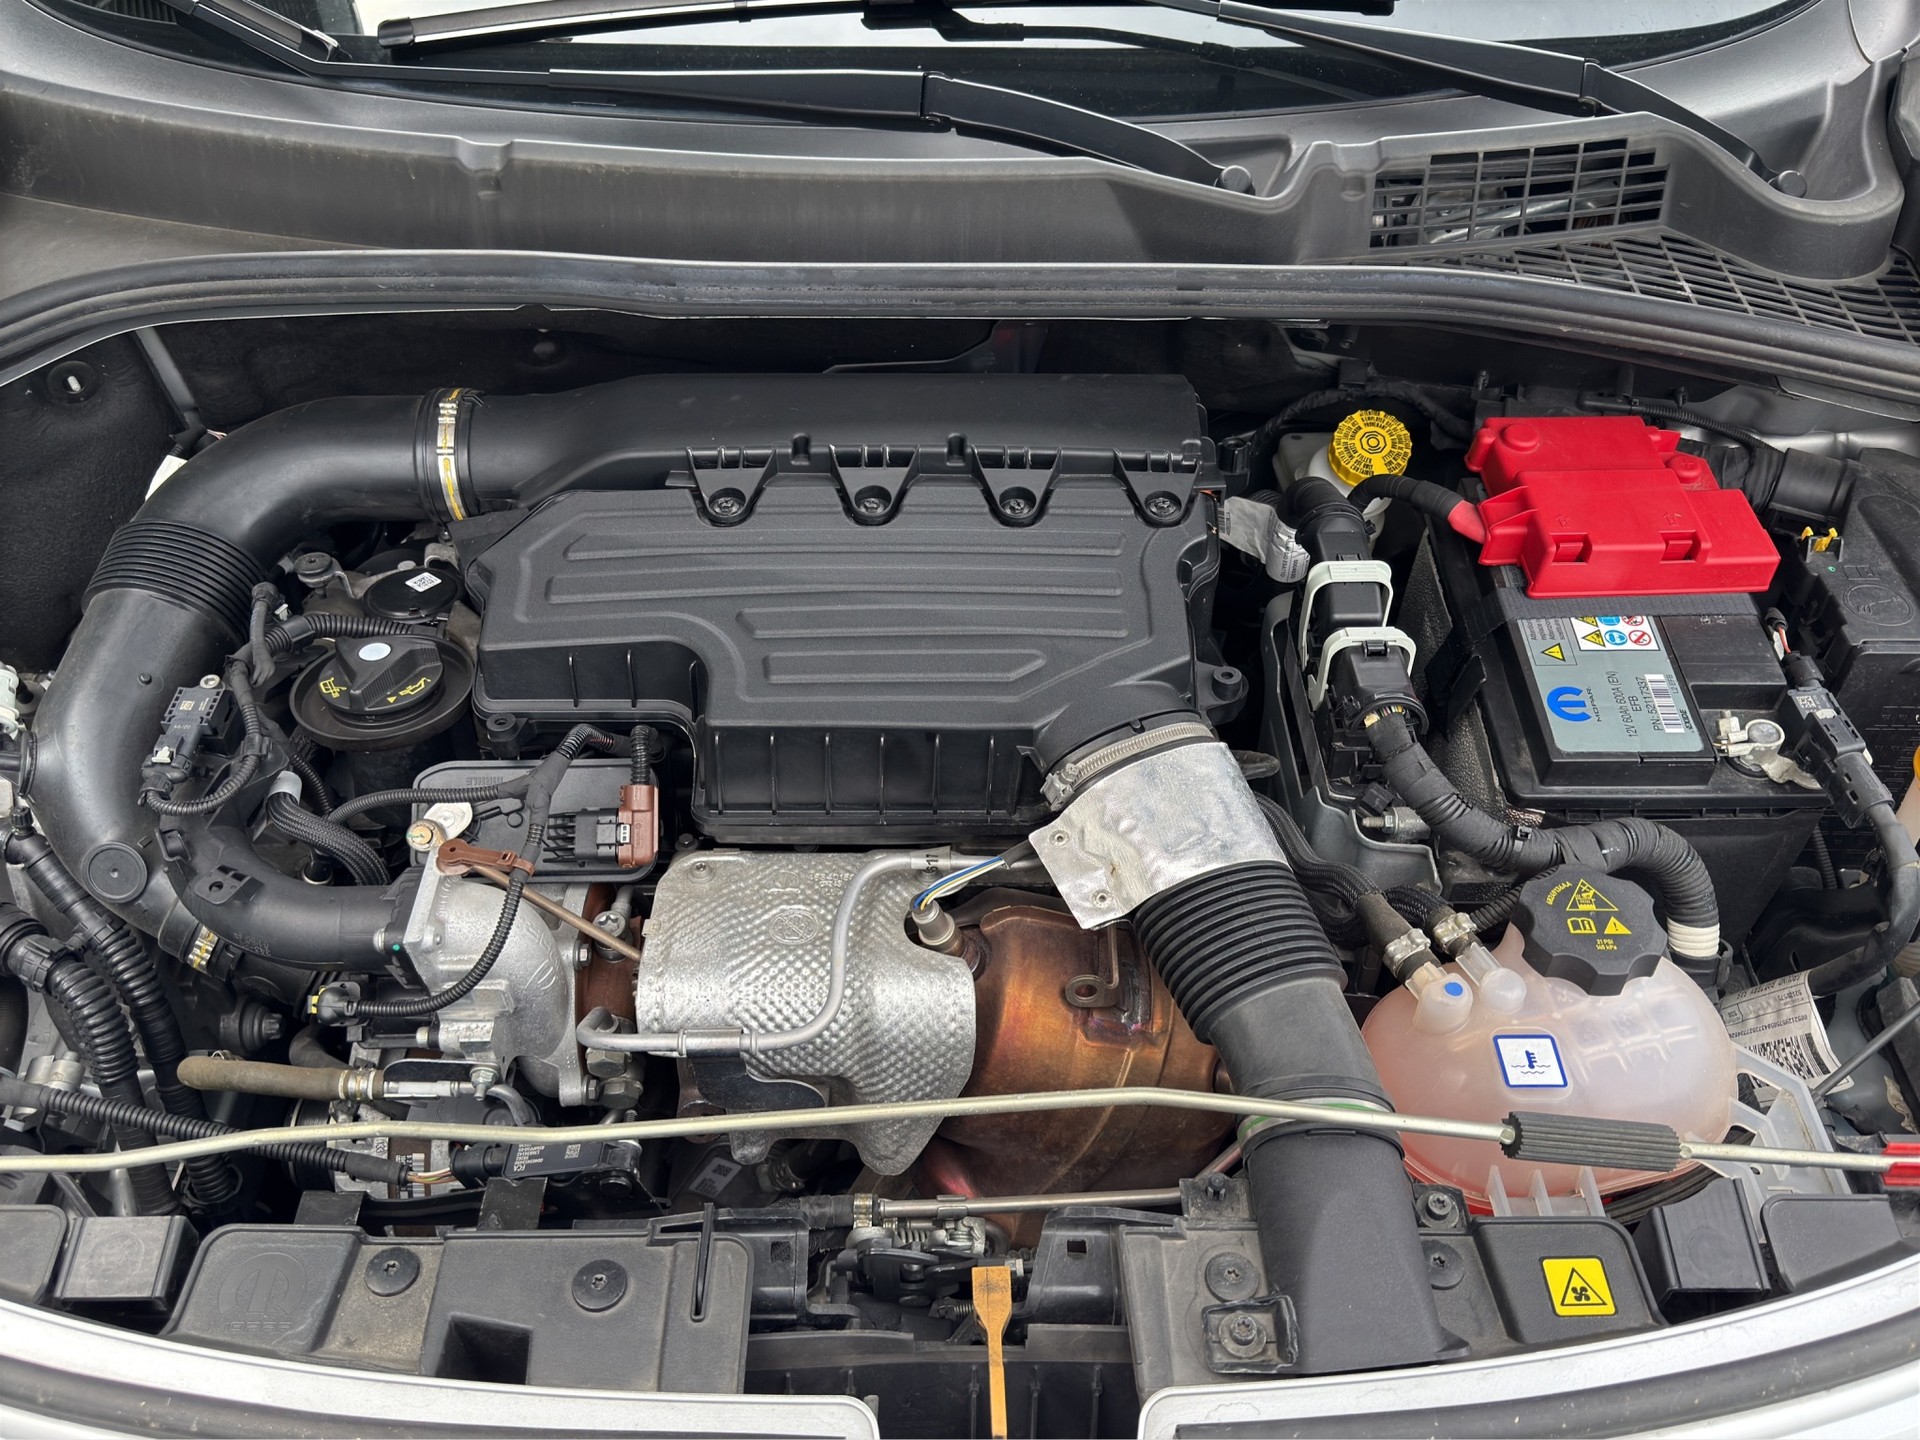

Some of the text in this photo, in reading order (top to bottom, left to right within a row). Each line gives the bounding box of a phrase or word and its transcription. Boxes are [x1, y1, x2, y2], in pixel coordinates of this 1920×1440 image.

[1586, 688, 1602, 722] MOPAR
[1606, 671, 1638, 737] 12V 60Ah 600A (EN)
[1628, 695, 1642, 712] EFB
[1635, 677, 1657, 715] 52117337
[513, 1164, 526, 1172] FCA
